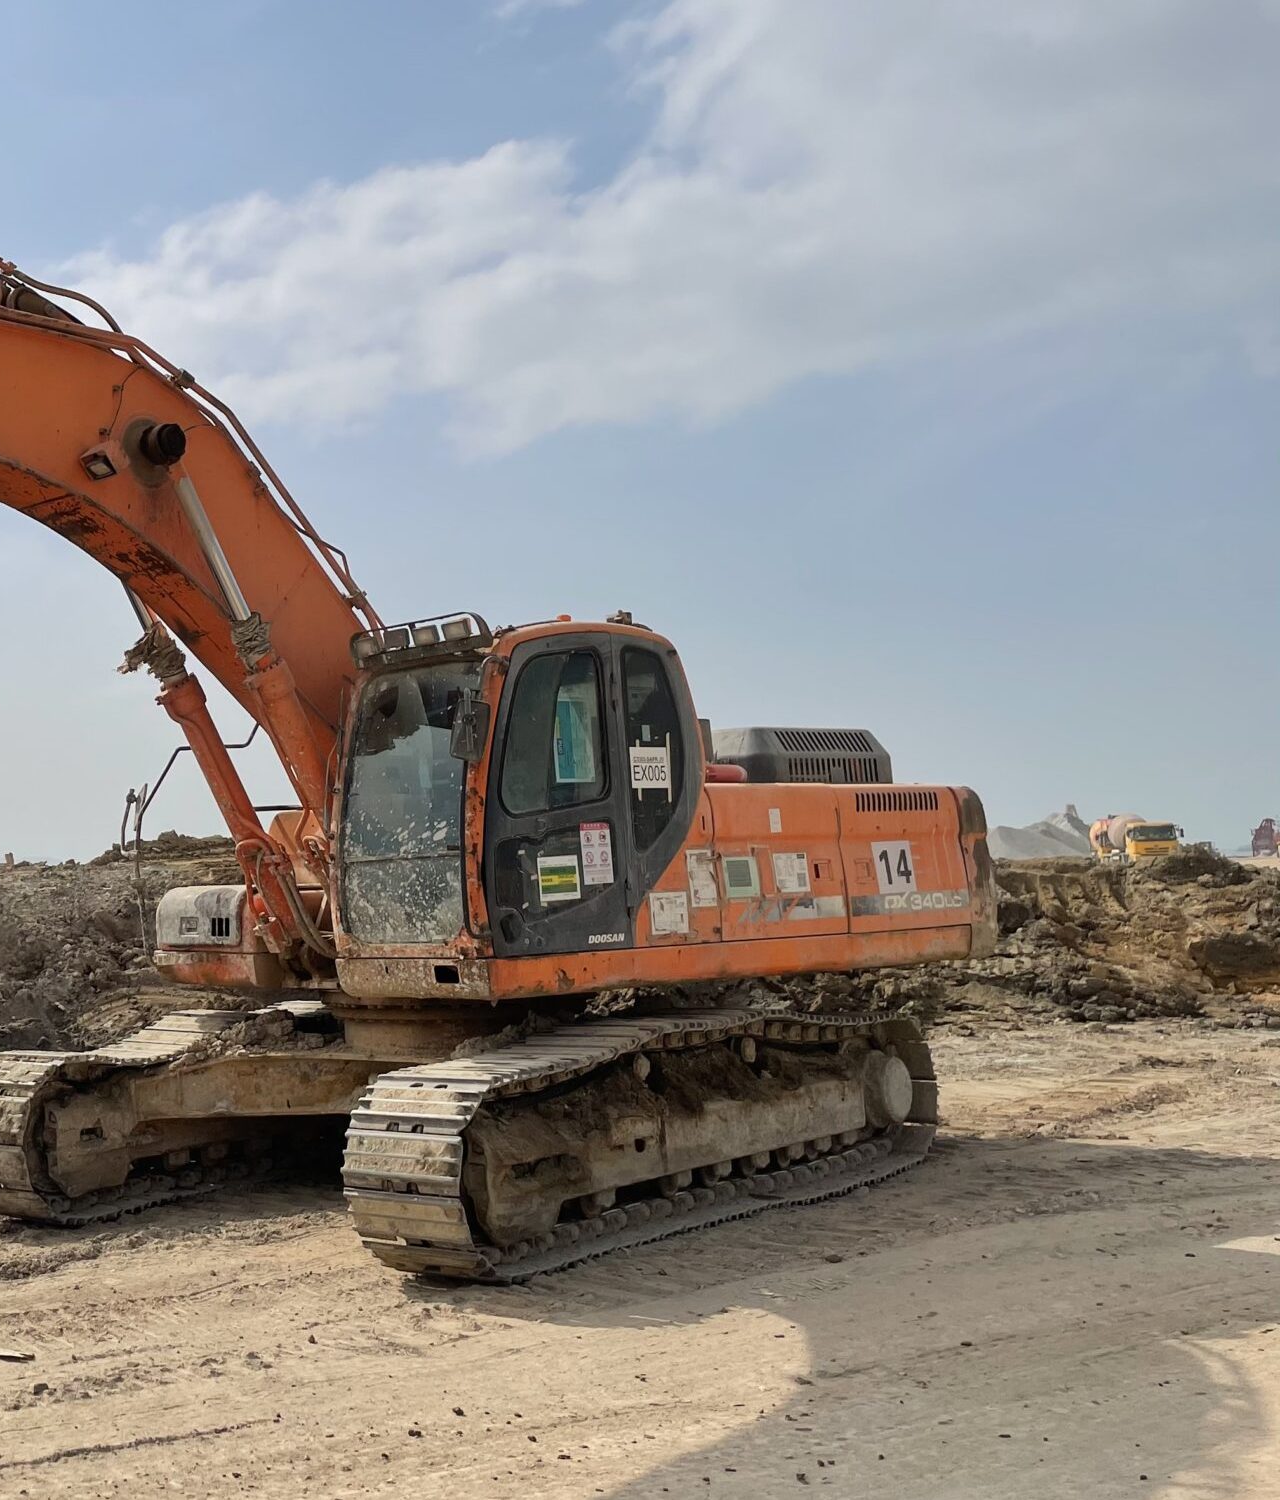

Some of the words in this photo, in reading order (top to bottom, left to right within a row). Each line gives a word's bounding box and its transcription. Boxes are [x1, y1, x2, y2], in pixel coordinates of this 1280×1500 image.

[633, 764, 667, 781] EX005
[879, 849, 912, 885] 14
[588, 933, 625, 944] DOOSAN
